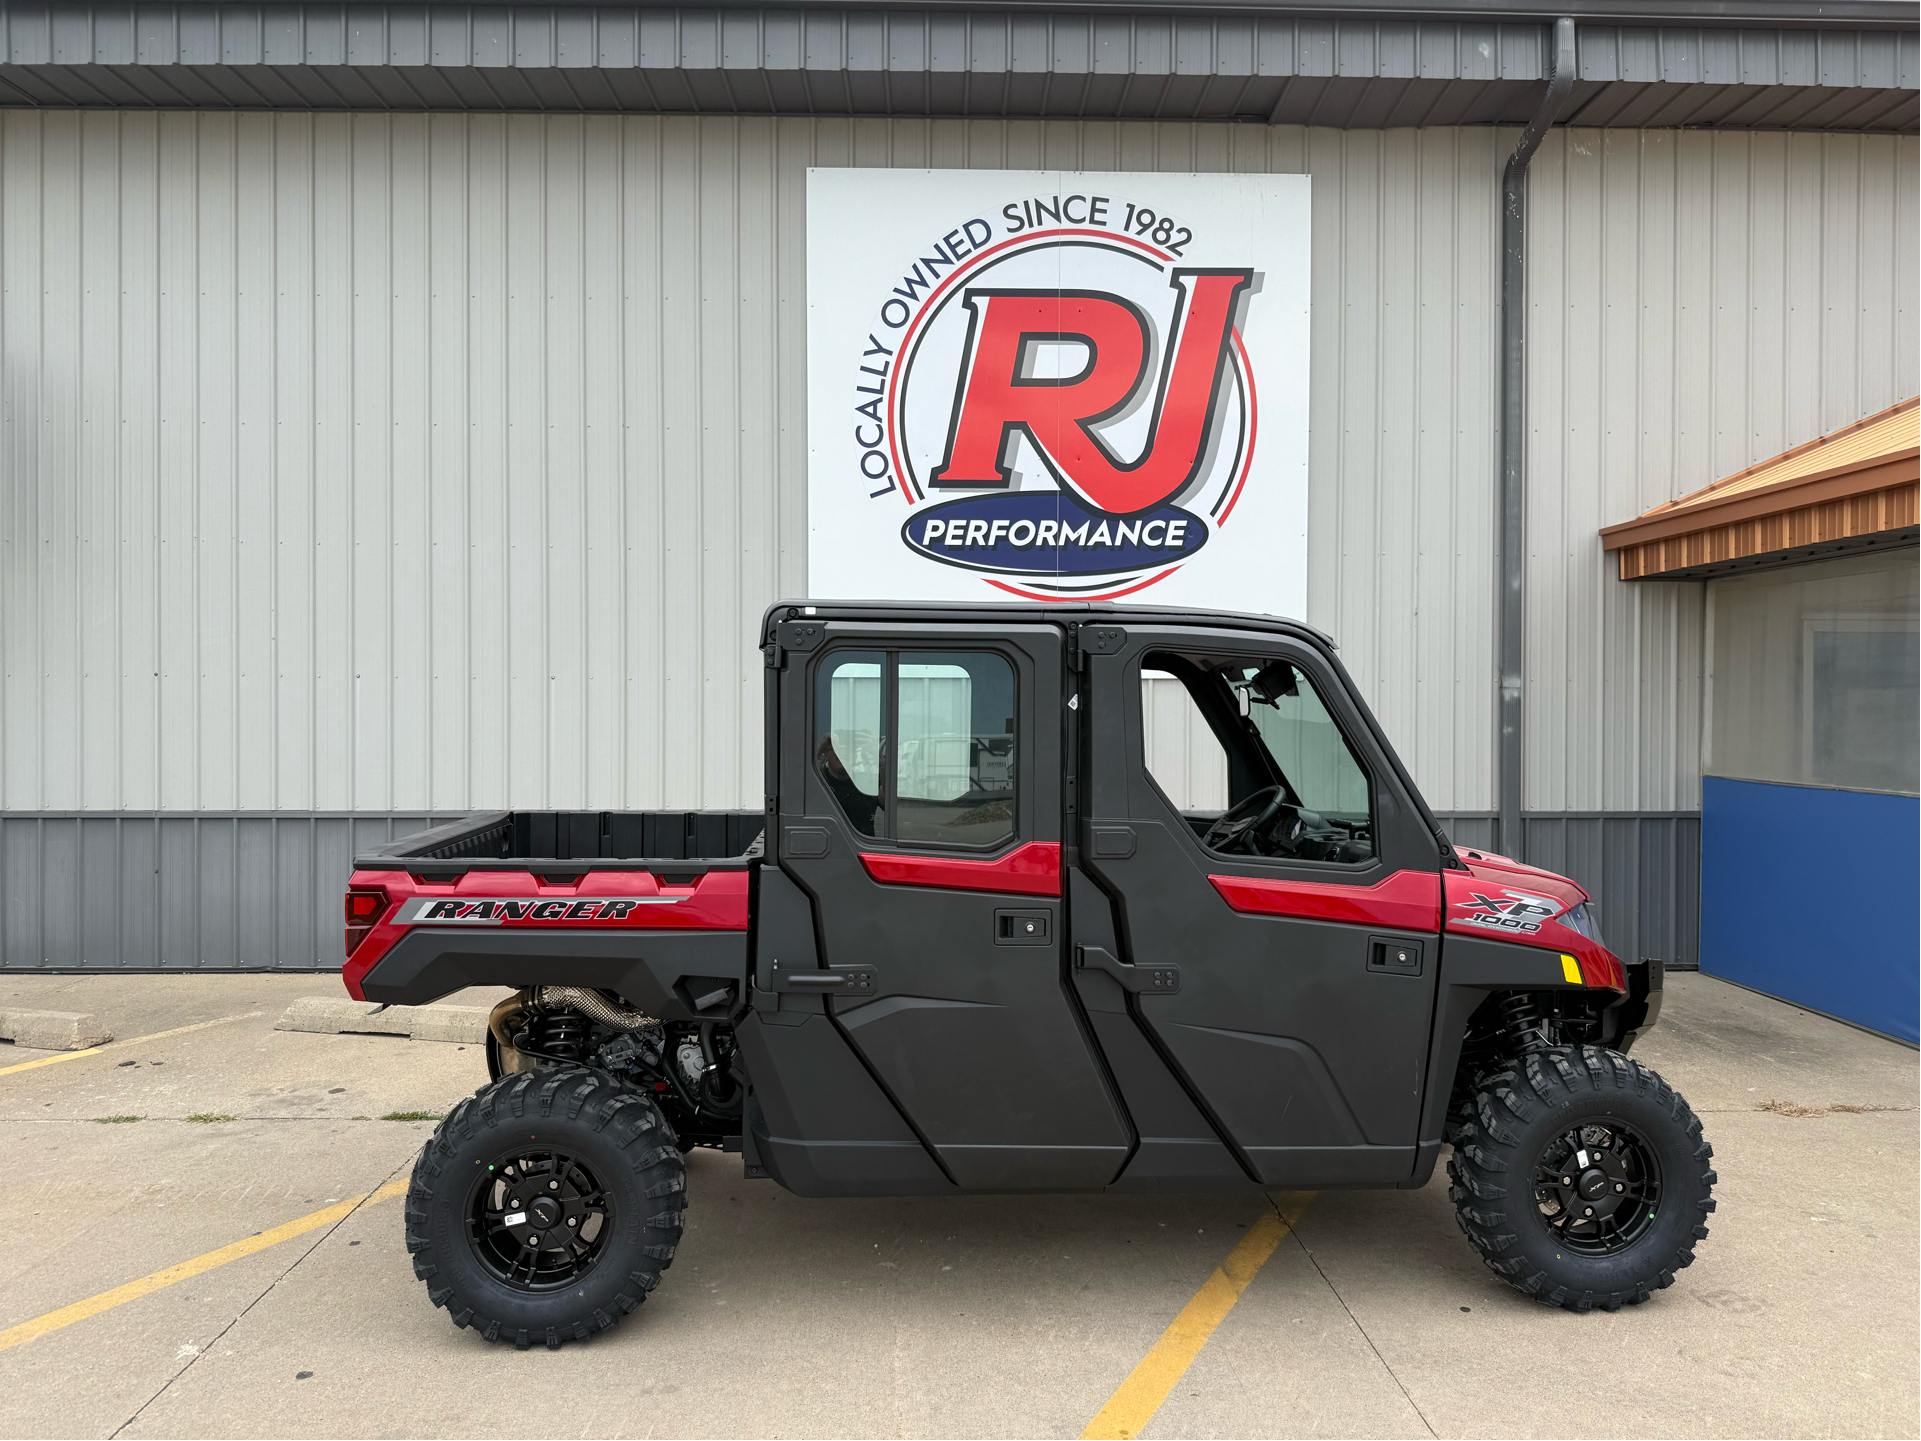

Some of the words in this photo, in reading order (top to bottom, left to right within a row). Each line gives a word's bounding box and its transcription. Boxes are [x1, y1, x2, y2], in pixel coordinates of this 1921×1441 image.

[855, 333, 897, 498] LOCALLY
[881, 218, 992, 328] OWNED
[1002, 195, 1110, 234] SINCE
[1122, 202, 1193, 257] 1982
[928, 266, 1256, 521] RJ
[922, 518, 1188, 548] PERFORMANCE
[423, 899, 639, 922] RANGER
[1453, 892, 1555, 916] XP
[1472, 913, 1542, 932] 1000
